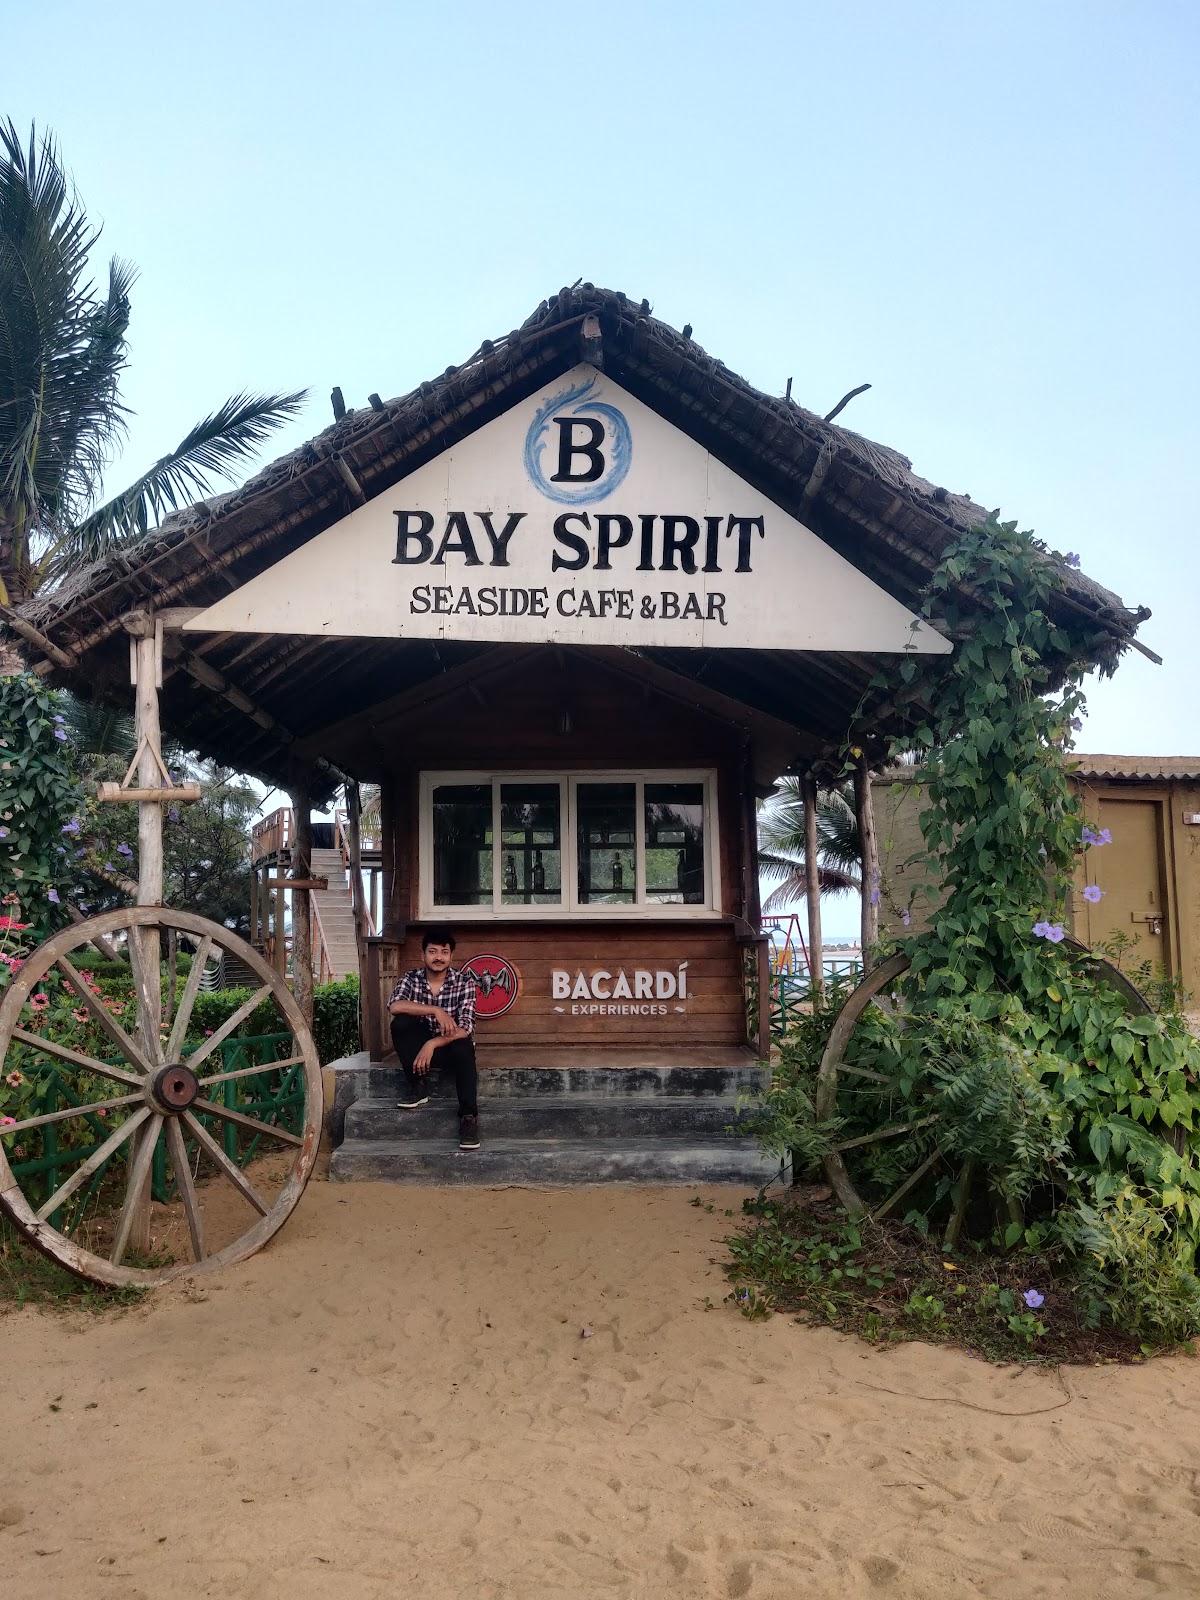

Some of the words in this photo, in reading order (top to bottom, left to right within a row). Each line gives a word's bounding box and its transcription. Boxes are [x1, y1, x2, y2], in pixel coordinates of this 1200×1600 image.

[550, 417, 606, 482] B
[391, 510, 528, 567] BAY
[551, 511, 765, 575] SPIRIT
[409, 584, 549, 619] SEASIDE
[556, 587, 634, 620] CAFE
[571, 1004, 668, 1015] EXPERIENCES
